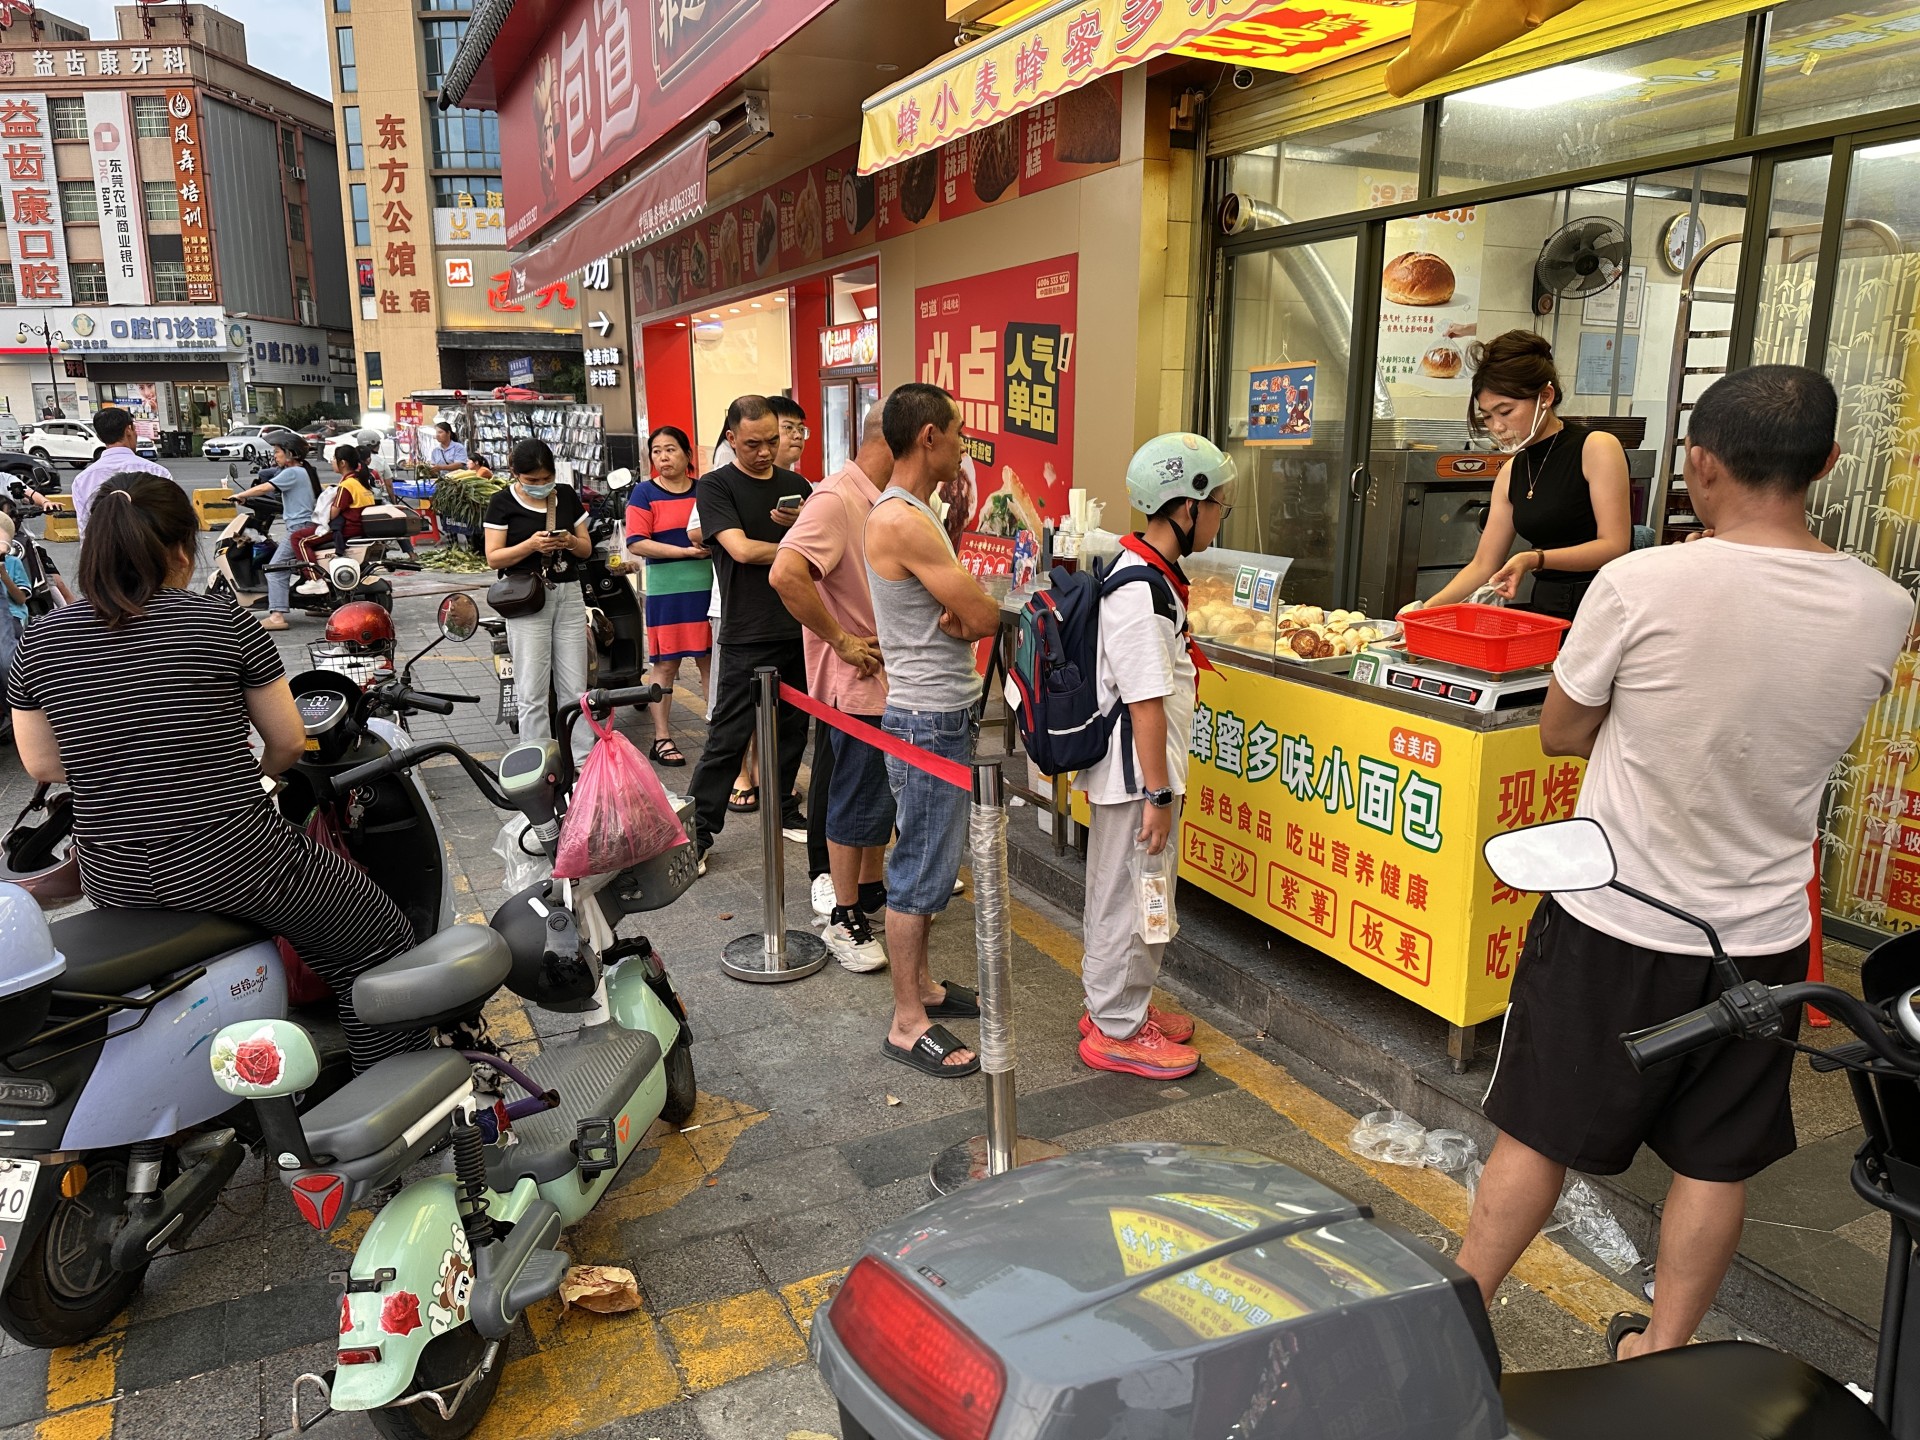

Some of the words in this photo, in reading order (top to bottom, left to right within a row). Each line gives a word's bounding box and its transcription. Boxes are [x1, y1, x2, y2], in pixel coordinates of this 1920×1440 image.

[32, 47, 186, 76] 益齿康牙科
[97, 159, 110, 183] DRC
[0, 98, 62, 299] 益齿康口腔
[101, 187, 114, 216] Bank
[375, 113, 417, 277] 东方公馆
[1371, 183, 1476, 223] 温示
[109, 159, 134, 278] 东莞农村商业银行
[475, 212, 504, 229] 24
[379, 288, 431, 314] 住宿
[920, 299, 938, 319] 包道
[110, 316, 217, 340] 口腔门诊部
[583, 347, 620, 366] 金美市场
[590, 369, 617, 386] 步行街
[1007, 378, 1055, 434] 单品
[1393, 733, 1438, 764] 金美店
[1189, 702, 1443, 853] 蜂蜜多味小面包
[1497, 762, 1582, 830] 现烤
[1189, 831, 1250, 886] 红豆沙
[1200, 785, 1273, 844] 绿色食品
[1286, 823, 1431, 912] 吃出营养健康
[1279, 874, 1331, 928] 紫薯
[1359, 913, 1421, 971] 板栗
